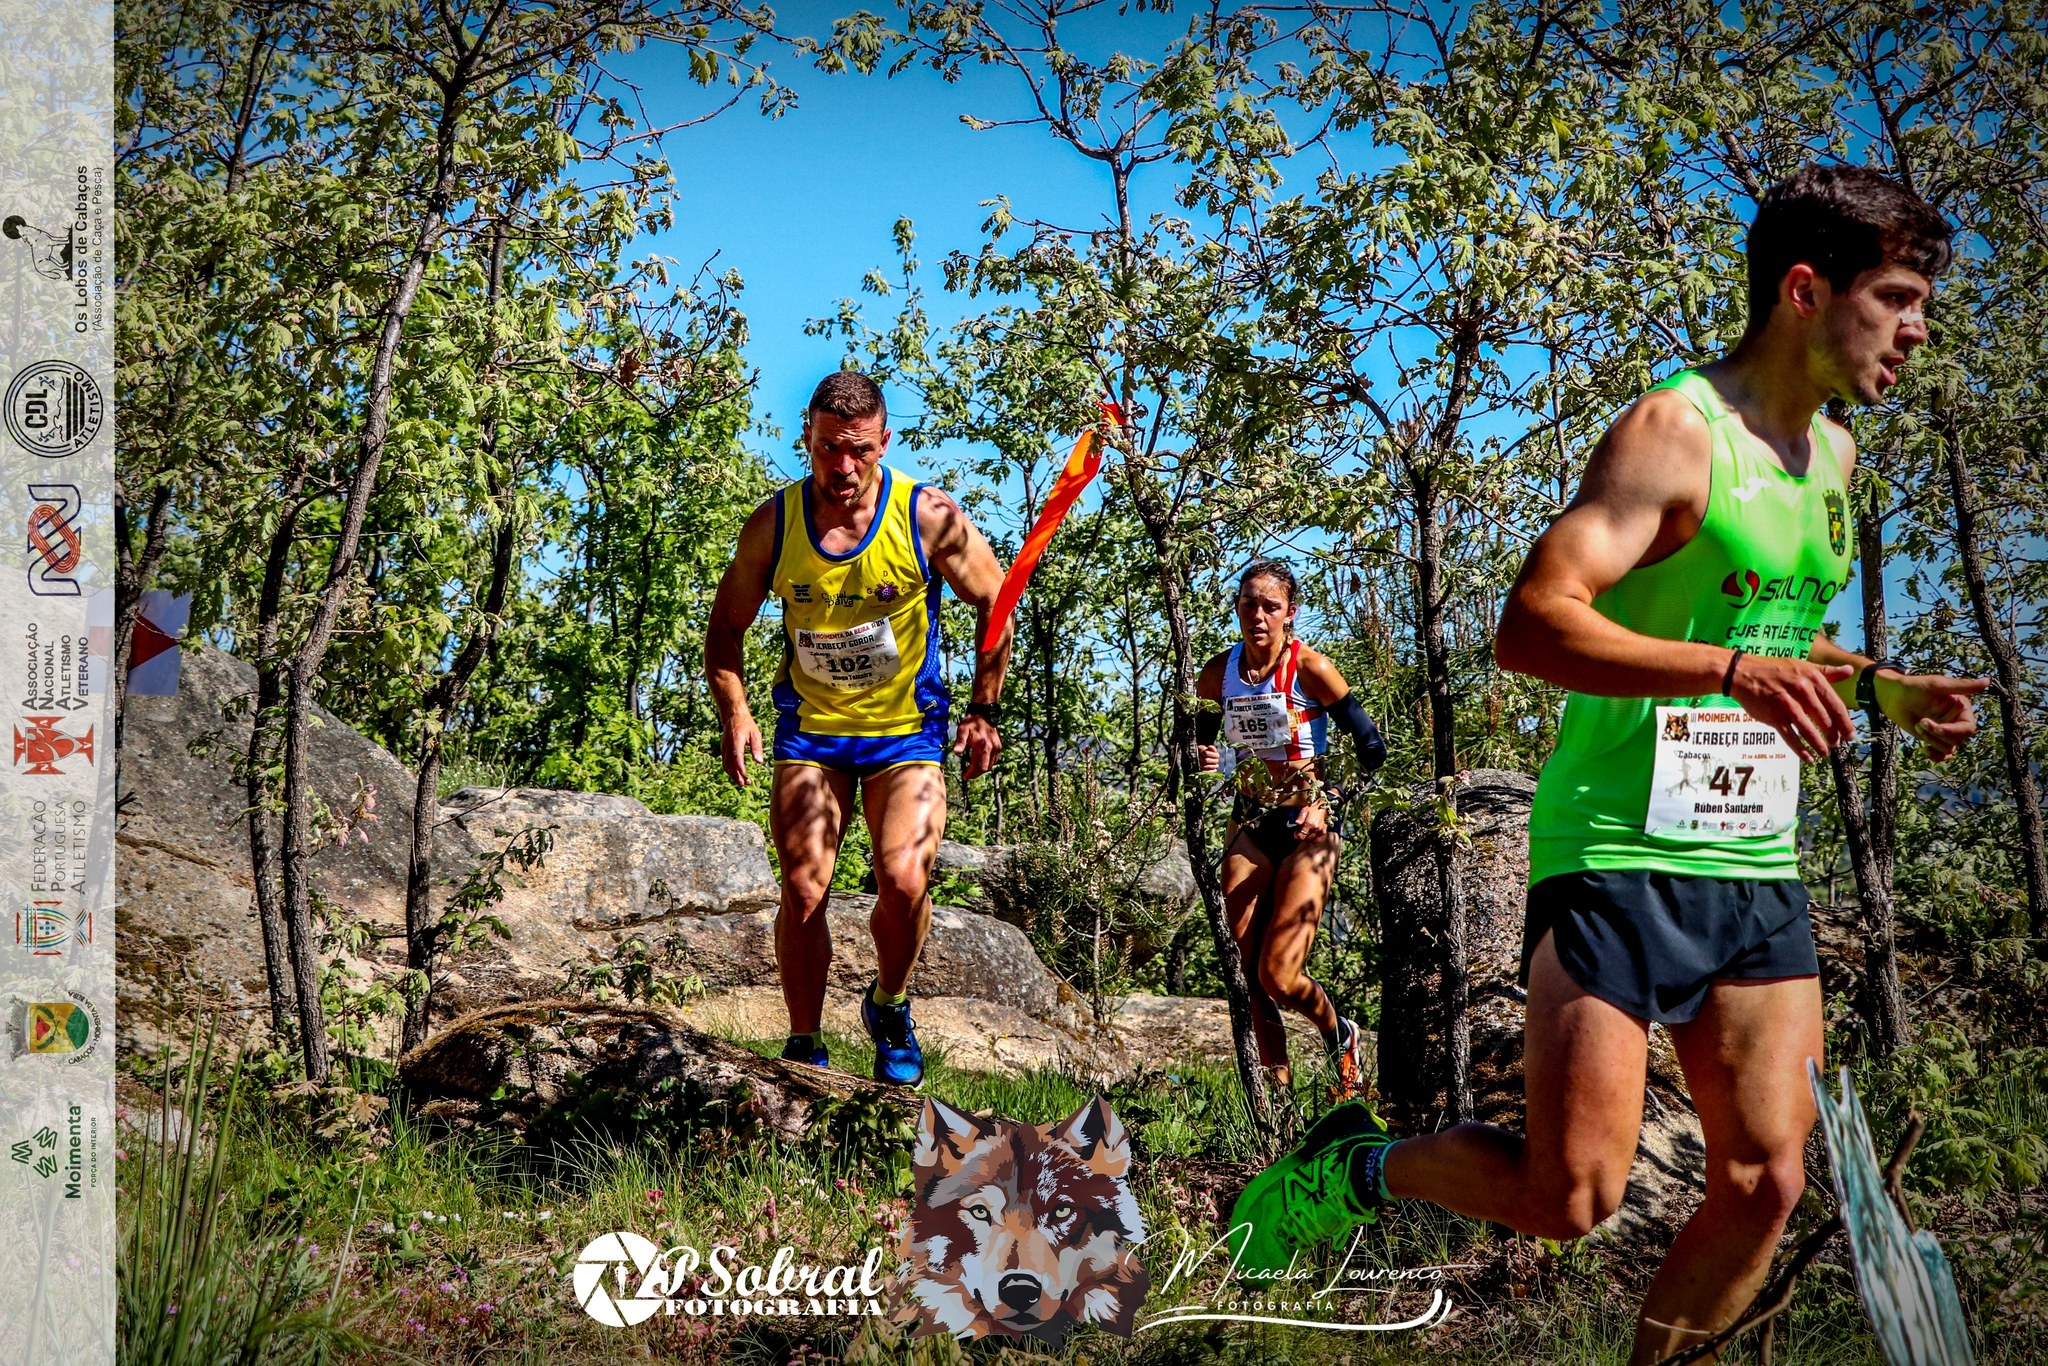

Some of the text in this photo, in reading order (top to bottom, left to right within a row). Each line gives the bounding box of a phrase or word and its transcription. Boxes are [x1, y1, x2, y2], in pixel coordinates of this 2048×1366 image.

[848, 634, 874, 648] GORDA
[826, 654, 872, 672] 102
[1698, 713, 1740, 722] MOIMENTA
[1238, 718, 1268, 732] 165
[1696, 732, 1738, 747] CABEÇA
[1743, 732, 1775, 745] GORDA
[1678, 750, 1711, 760] Cabaços
[1709, 766, 1755, 796] 47
[1694, 802, 1763, 813] Rúben Santarém
